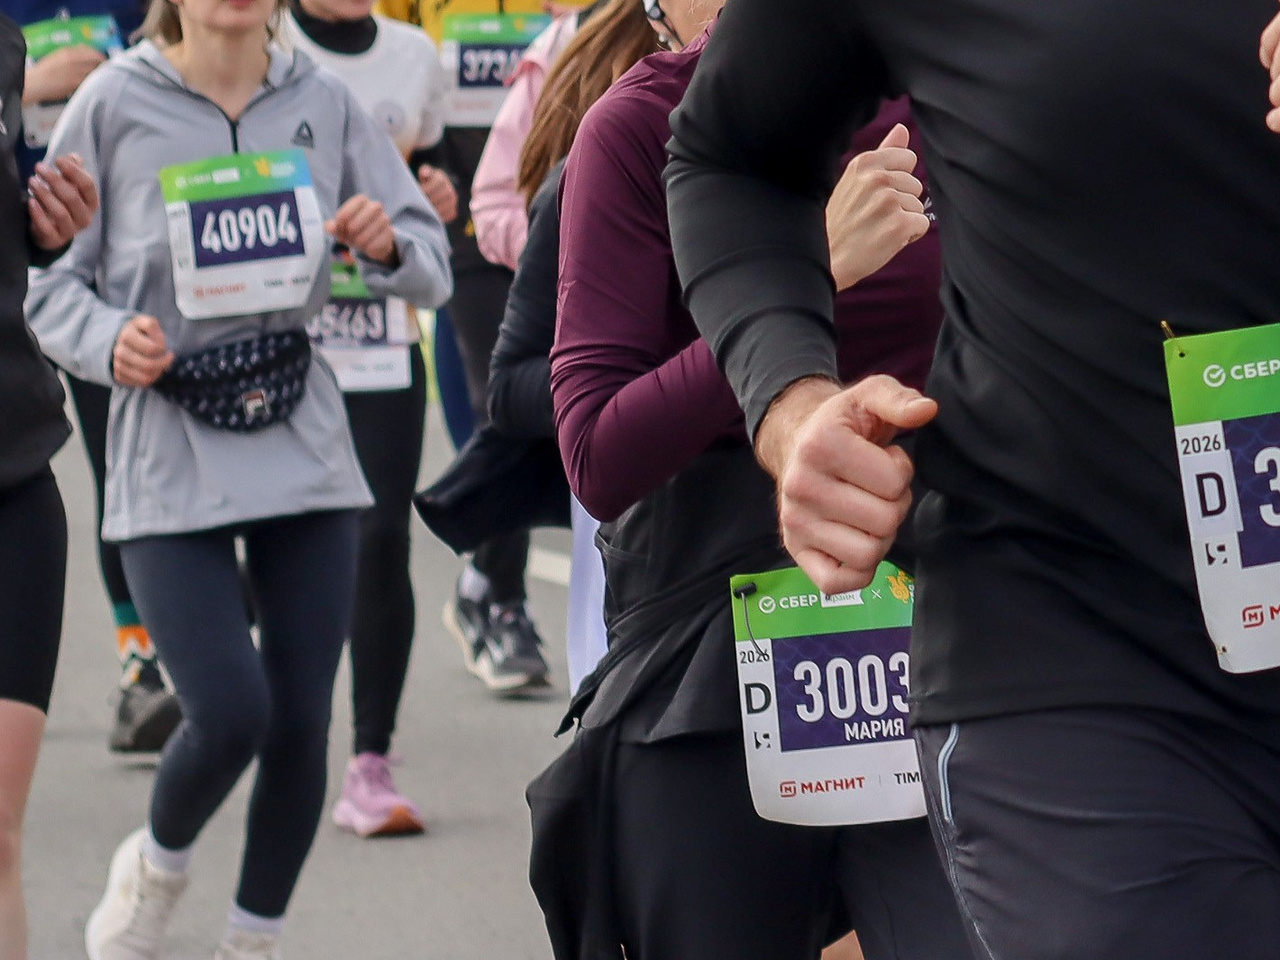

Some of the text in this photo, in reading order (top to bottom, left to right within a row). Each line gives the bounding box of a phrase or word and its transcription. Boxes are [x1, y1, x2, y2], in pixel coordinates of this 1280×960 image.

[201, 202, 298, 253] 40904
[1180, 433, 1222, 456] 2026
[1195, 471, 1228, 519] D
[778, 594, 819, 610] СБЕР
[739, 649, 771, 665] 2026
[744, 682, 772, 715] D
[793, 650, 910, 723] 3003
[844, 718, 905, 742] МАРИЯ
[800, 775, 866, 795] МАГНИТ
